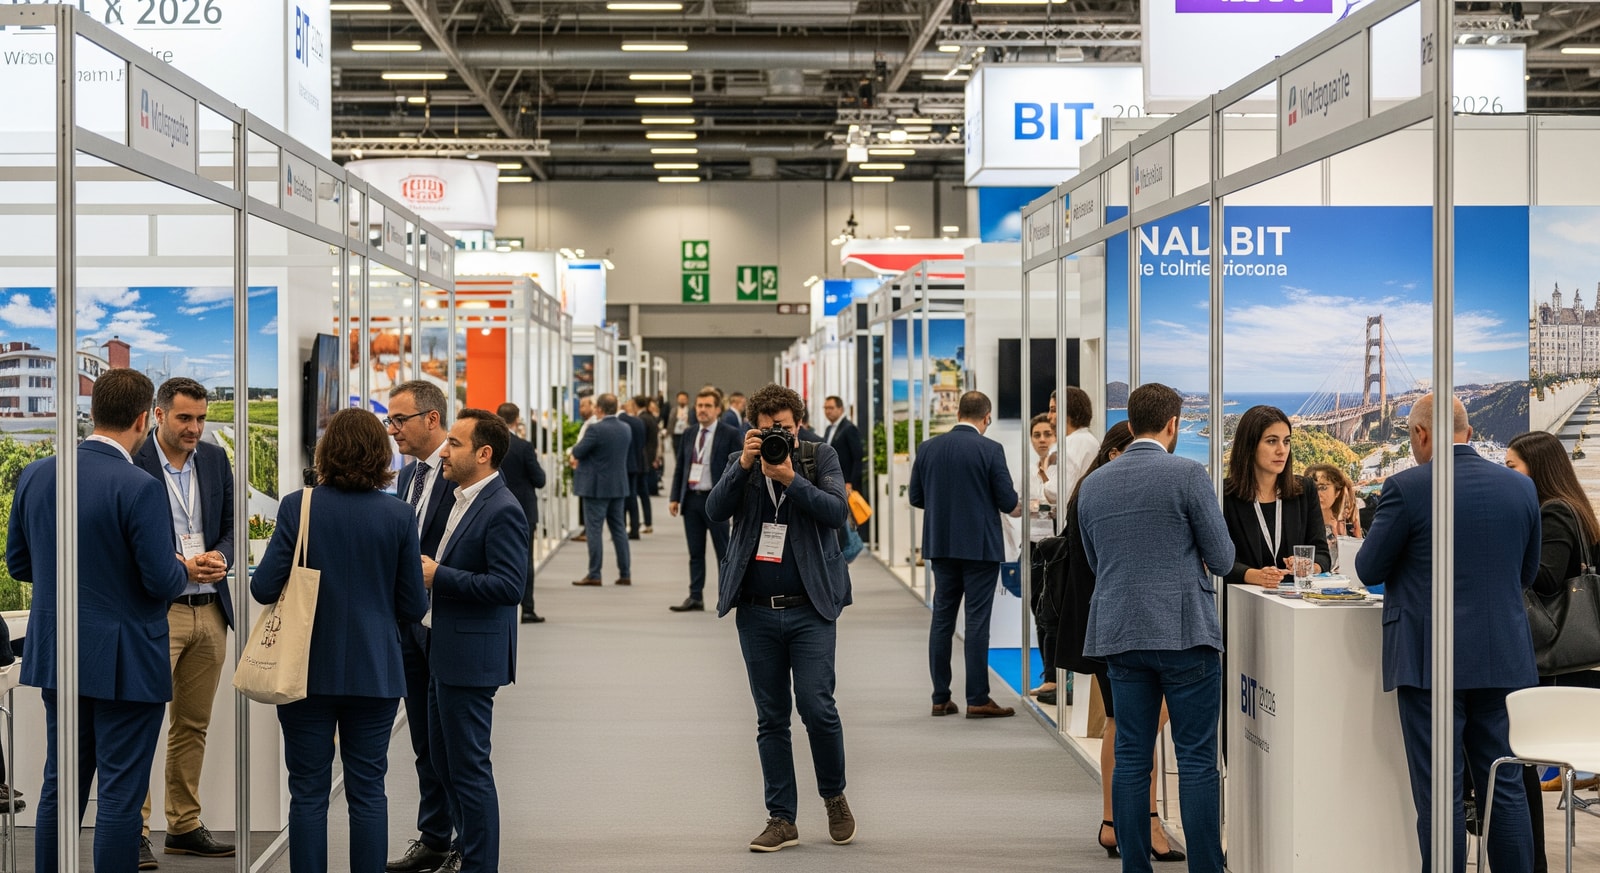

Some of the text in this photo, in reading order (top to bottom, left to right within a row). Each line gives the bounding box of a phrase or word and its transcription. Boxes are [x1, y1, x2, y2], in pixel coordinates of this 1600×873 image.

[137, 0, 223, 25] 2026
[296, 5, 310, 68] BIT
[1014, 102, 1095, 140] BIT
[1139, 226, 1291, 256] NALBIT
[1240, 672, 1257, 720] BIT
